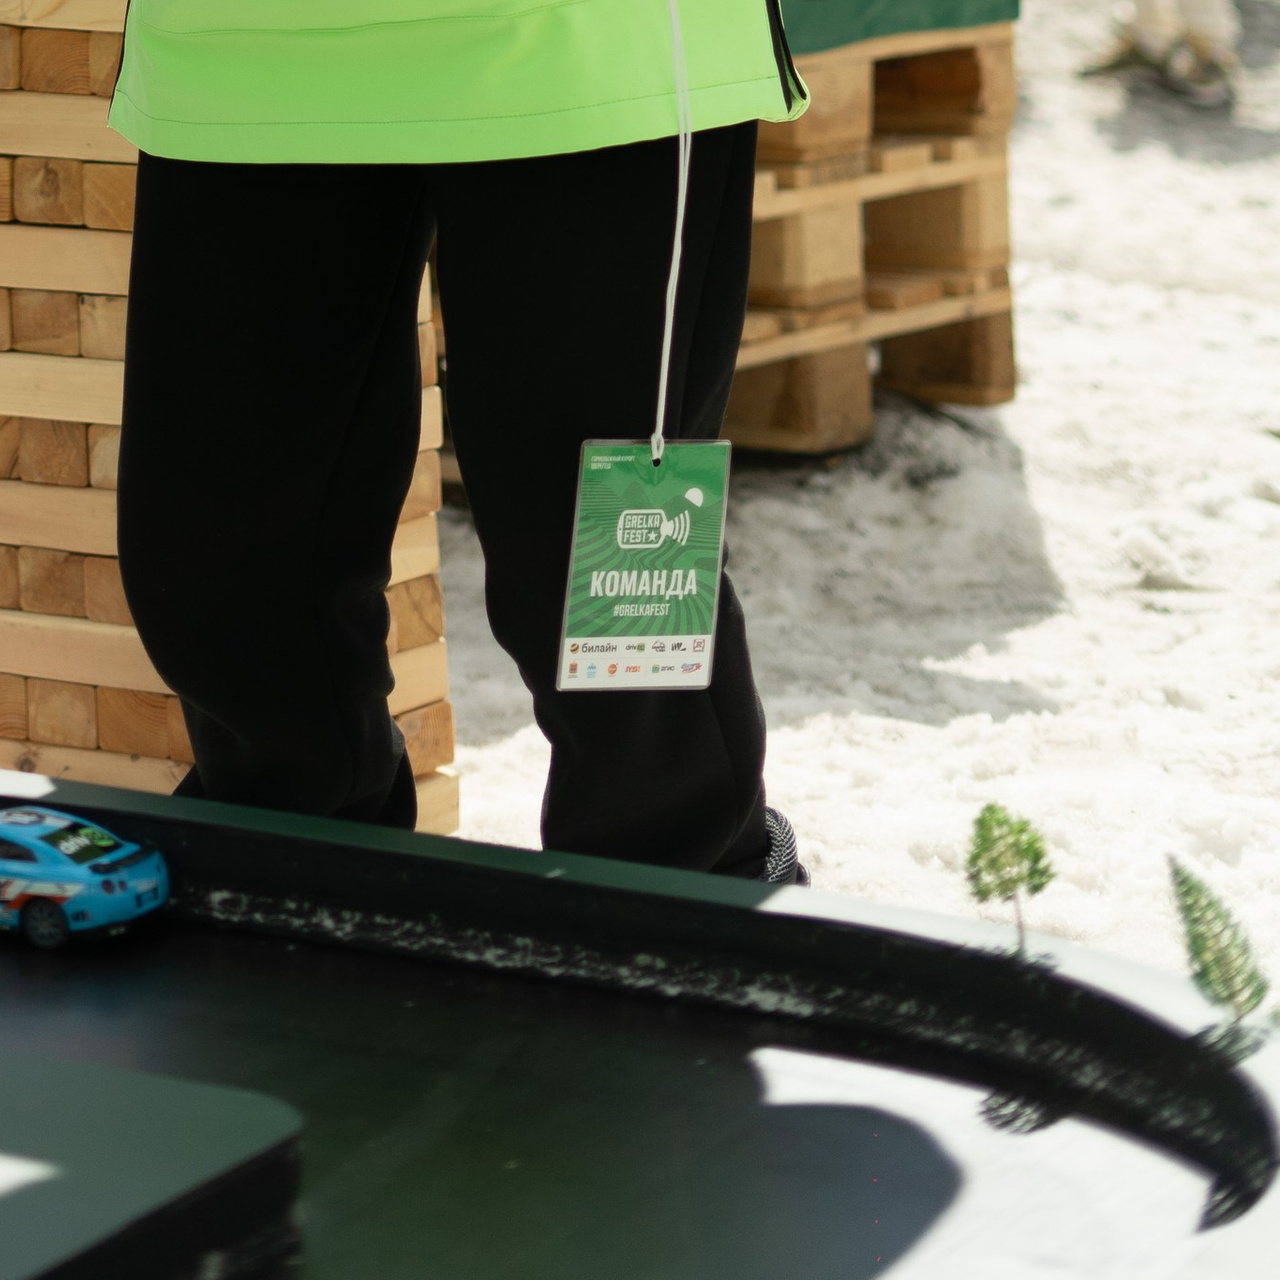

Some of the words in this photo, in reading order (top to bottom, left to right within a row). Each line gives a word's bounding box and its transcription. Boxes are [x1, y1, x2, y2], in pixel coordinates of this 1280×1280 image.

[625, 514, 660, 528] GRELKA
[623, 529, 648, 542] FEST
[590, 569, 697, 600] КОМАНДА
[613, 603, 670, 617] #GRELKAFEST
[581, 642, 617, 653] билайн
